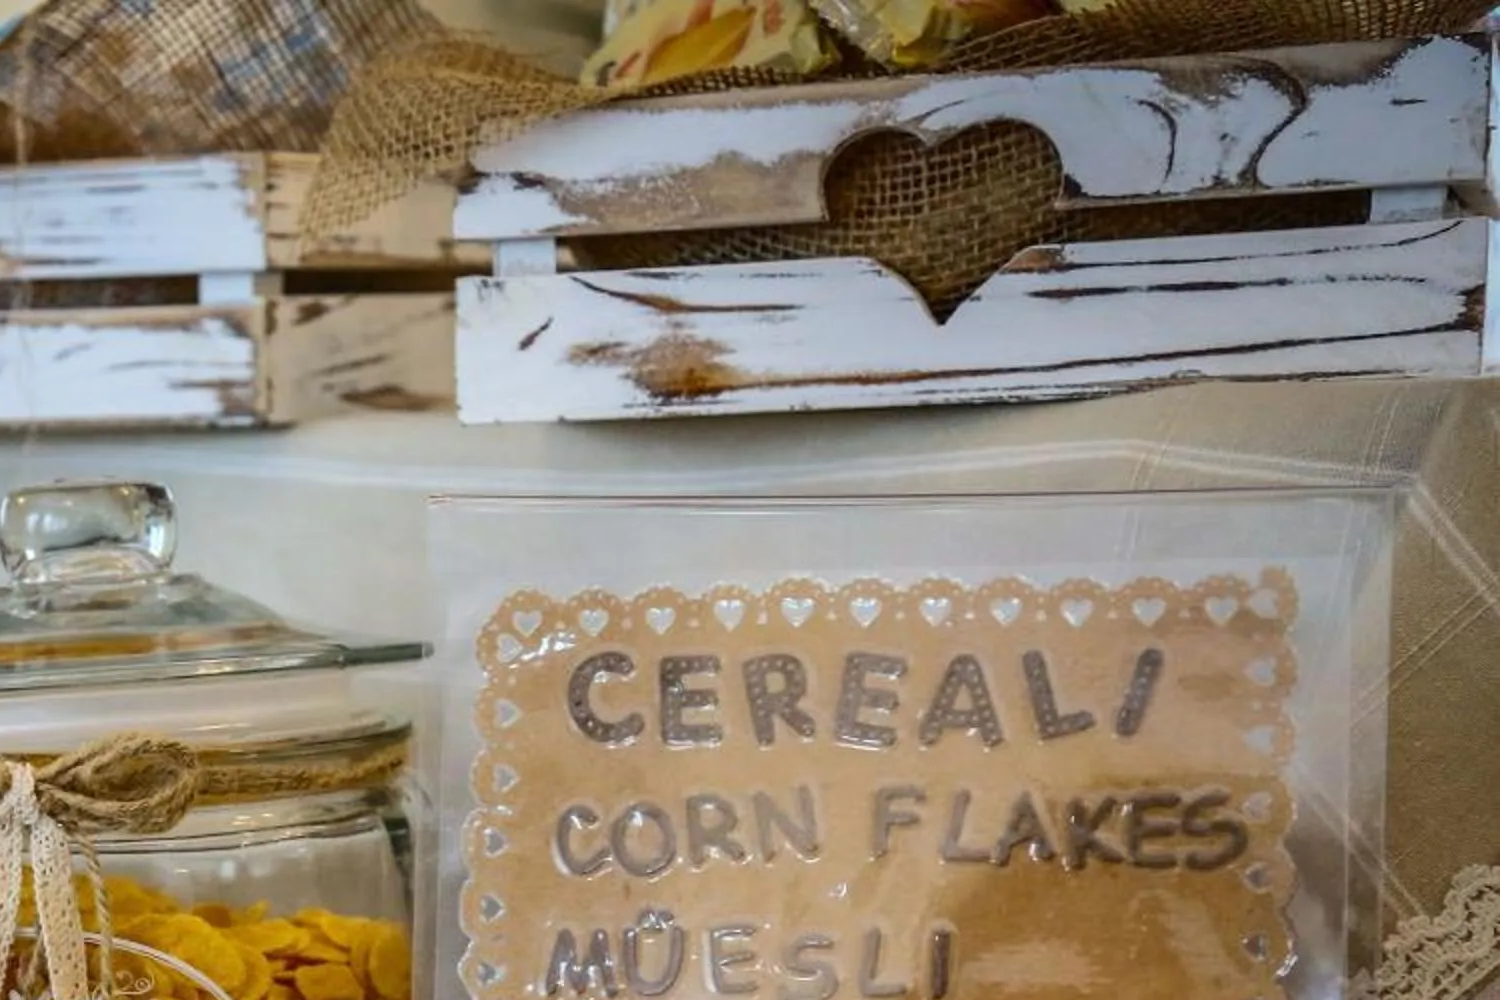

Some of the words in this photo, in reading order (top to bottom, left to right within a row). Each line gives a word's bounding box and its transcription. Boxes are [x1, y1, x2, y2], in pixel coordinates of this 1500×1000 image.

[566, 647, 1164, 749] CEREALI
[553, 784, 822, 877] CORN
[870, 786, 1249, 872] FLAKES
